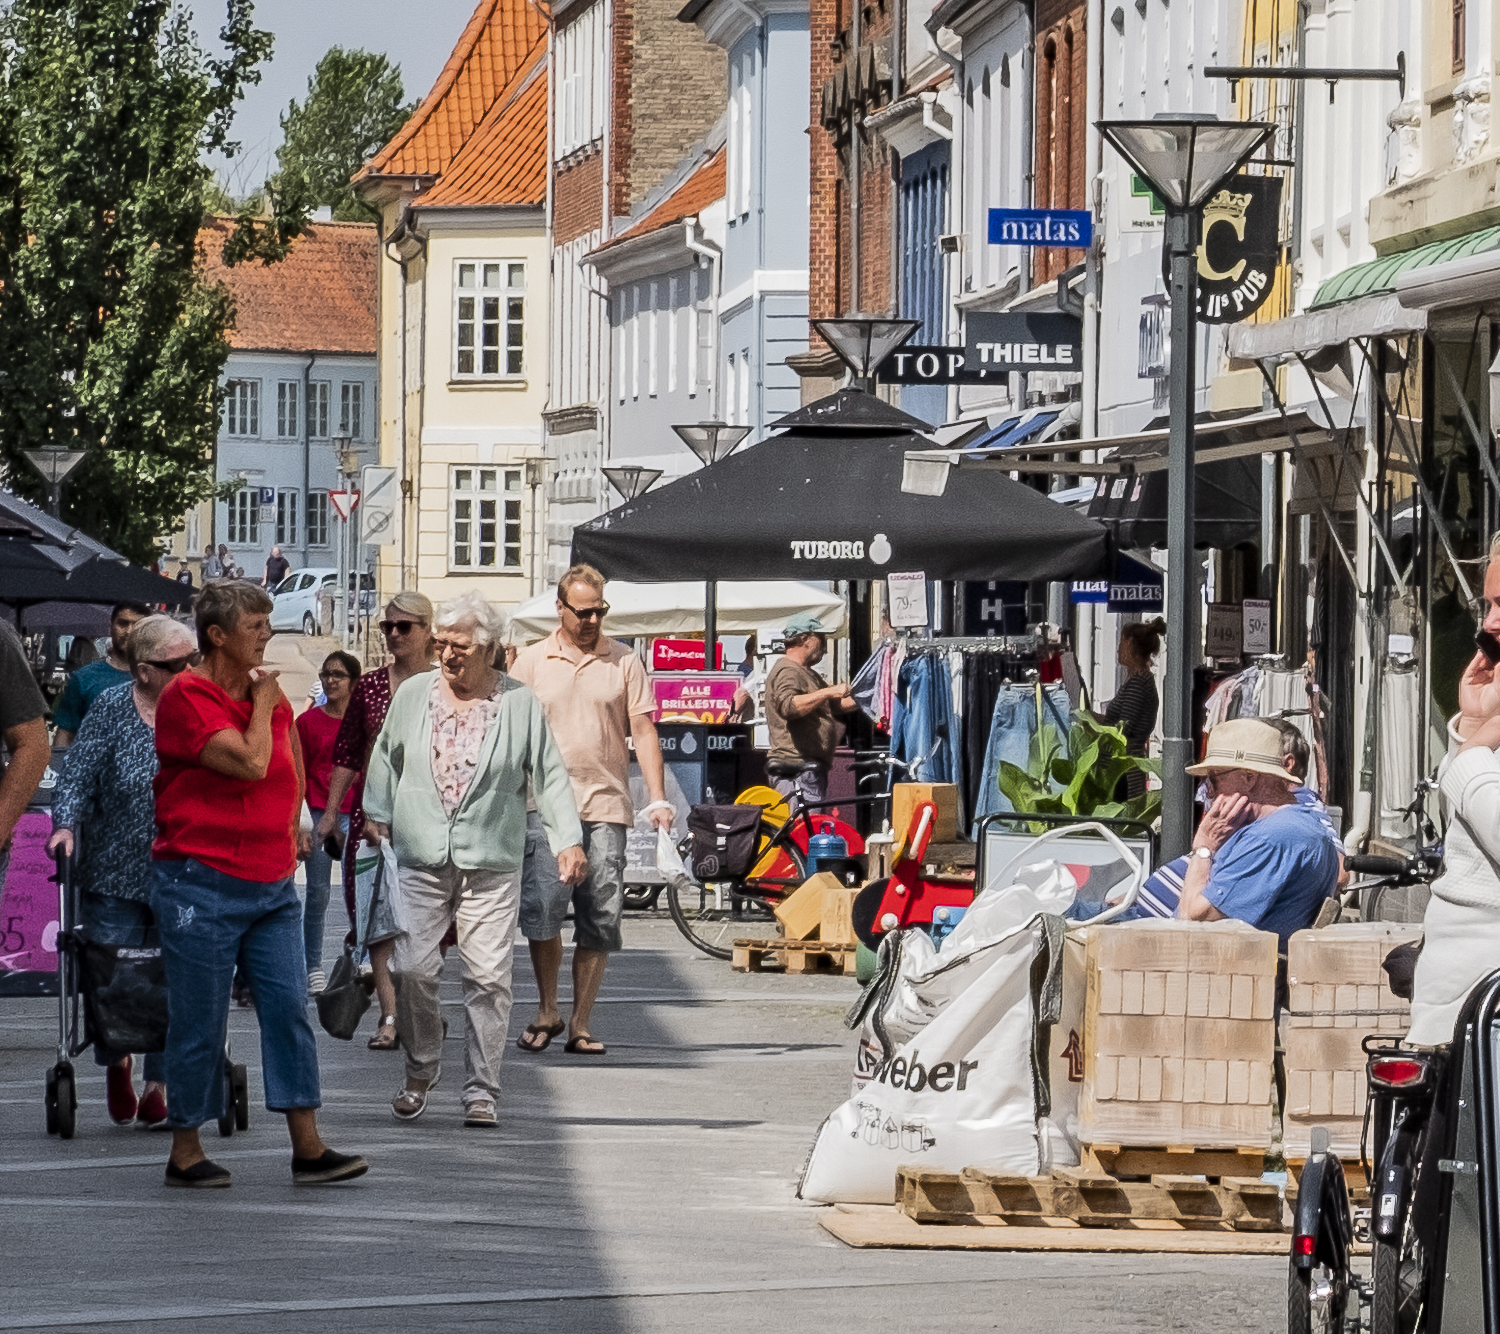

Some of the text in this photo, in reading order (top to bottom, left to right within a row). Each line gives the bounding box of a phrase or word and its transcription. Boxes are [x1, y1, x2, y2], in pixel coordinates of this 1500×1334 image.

[1001, 215, 1080, 242] matas
[1231, 269, 1268, 312] PUB
[976, 342, 1074, 364] THIELE
[790, 540, 865, 560] TUBORG
[1110, 583, 1162, 602] matas
[681, 685, 712, 697] ALLE
